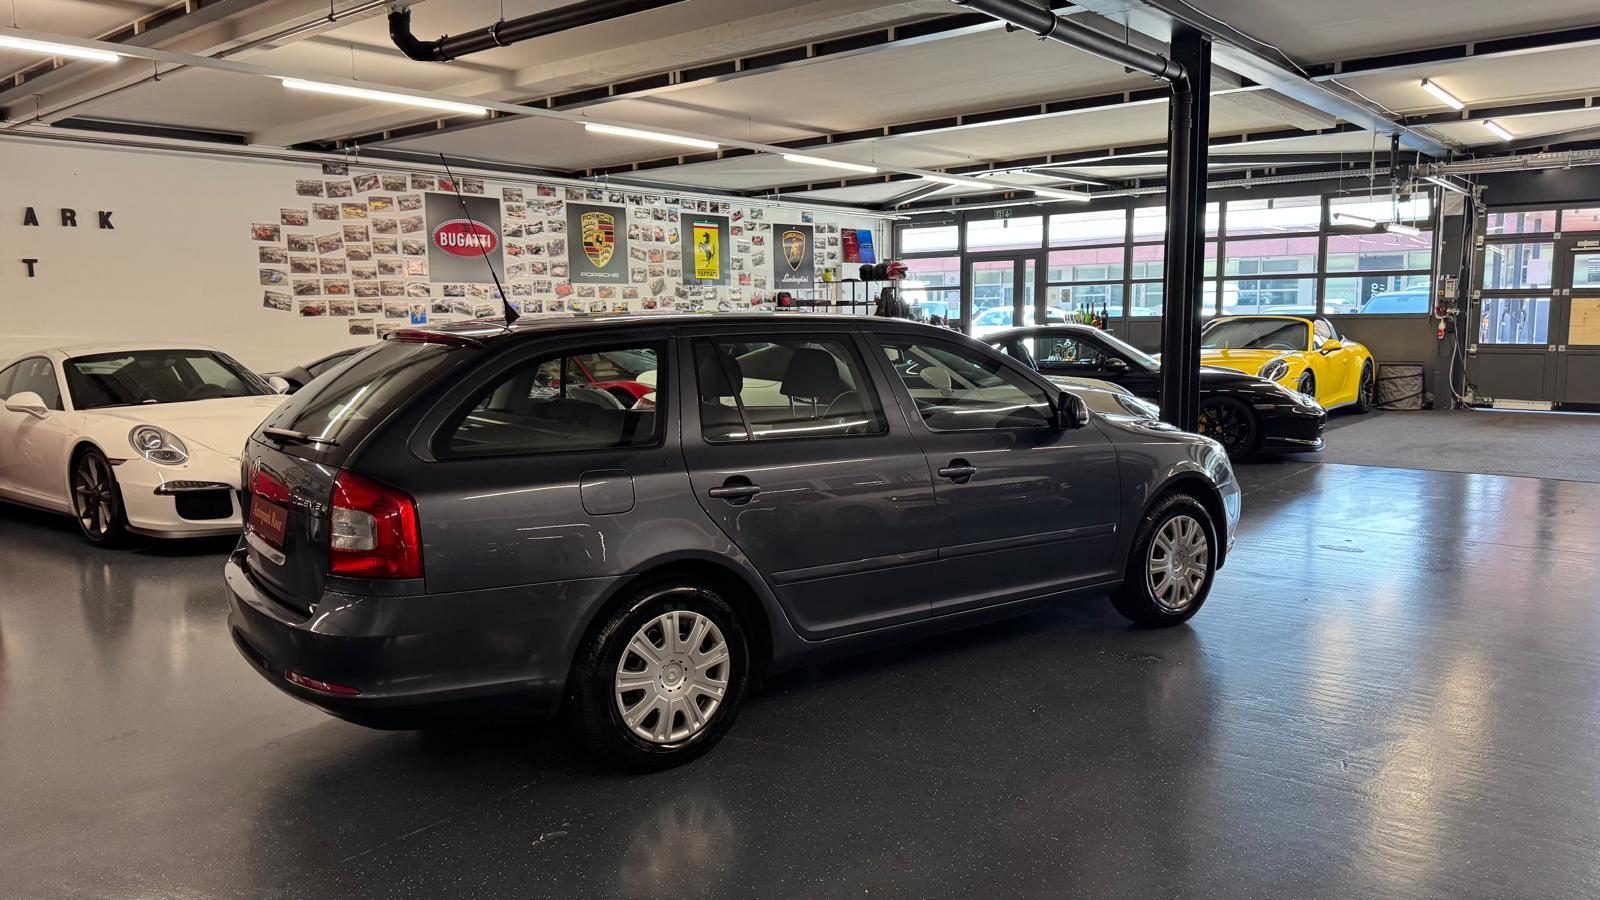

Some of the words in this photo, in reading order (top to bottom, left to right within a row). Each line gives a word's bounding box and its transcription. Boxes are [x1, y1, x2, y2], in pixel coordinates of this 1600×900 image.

[23, 206, 115, 230] ARK
[440, 232, 492, 248] BUGATTI
[22, 258, 38, 277] T
[697, 268, 718, 277] Ferrari
